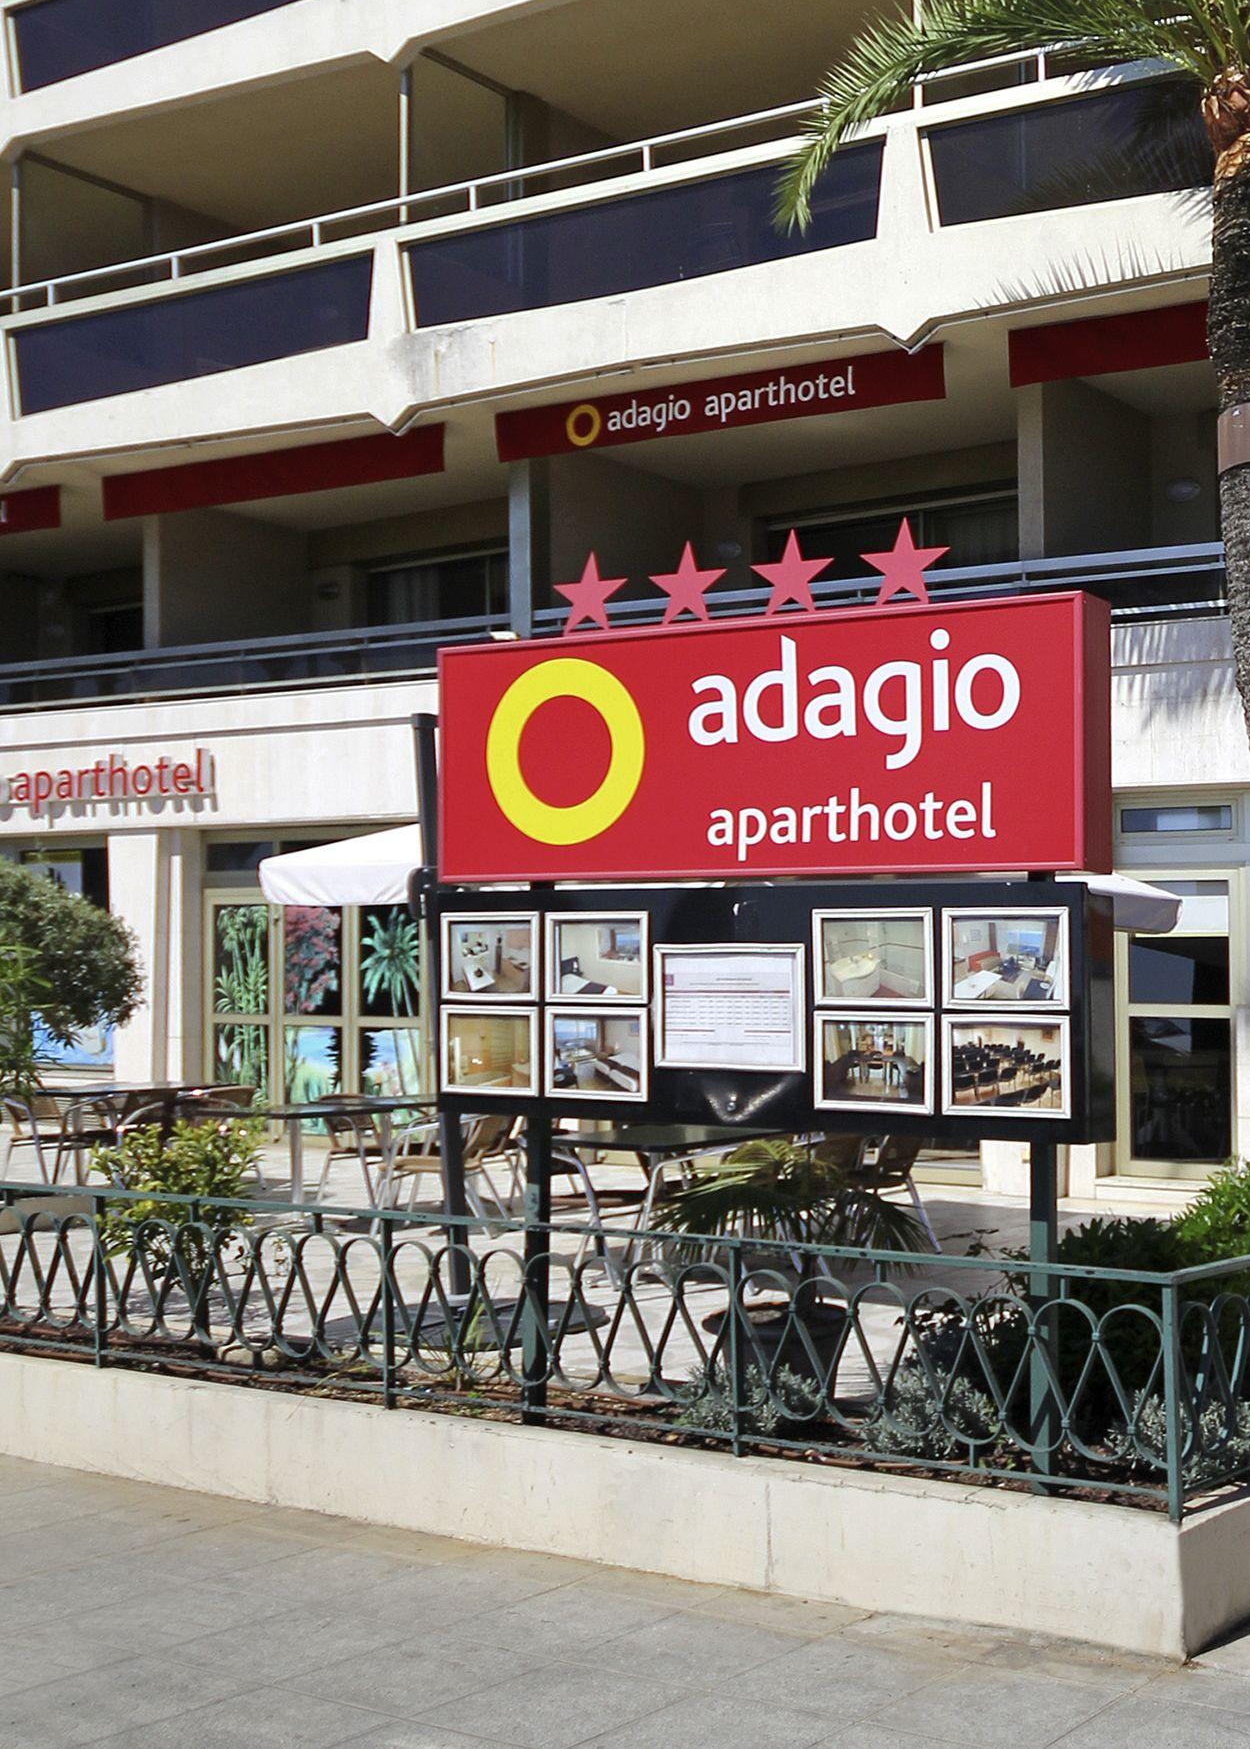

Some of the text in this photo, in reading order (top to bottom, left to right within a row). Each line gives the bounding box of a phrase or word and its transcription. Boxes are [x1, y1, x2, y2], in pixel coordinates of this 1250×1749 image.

[607, 365, 856, 432] adagio aparthotel
[688, 628, 1021, 770] adagio
[14, 748, 205, 814] aparthotel
[706, 781, 997, 862] aparthotel
